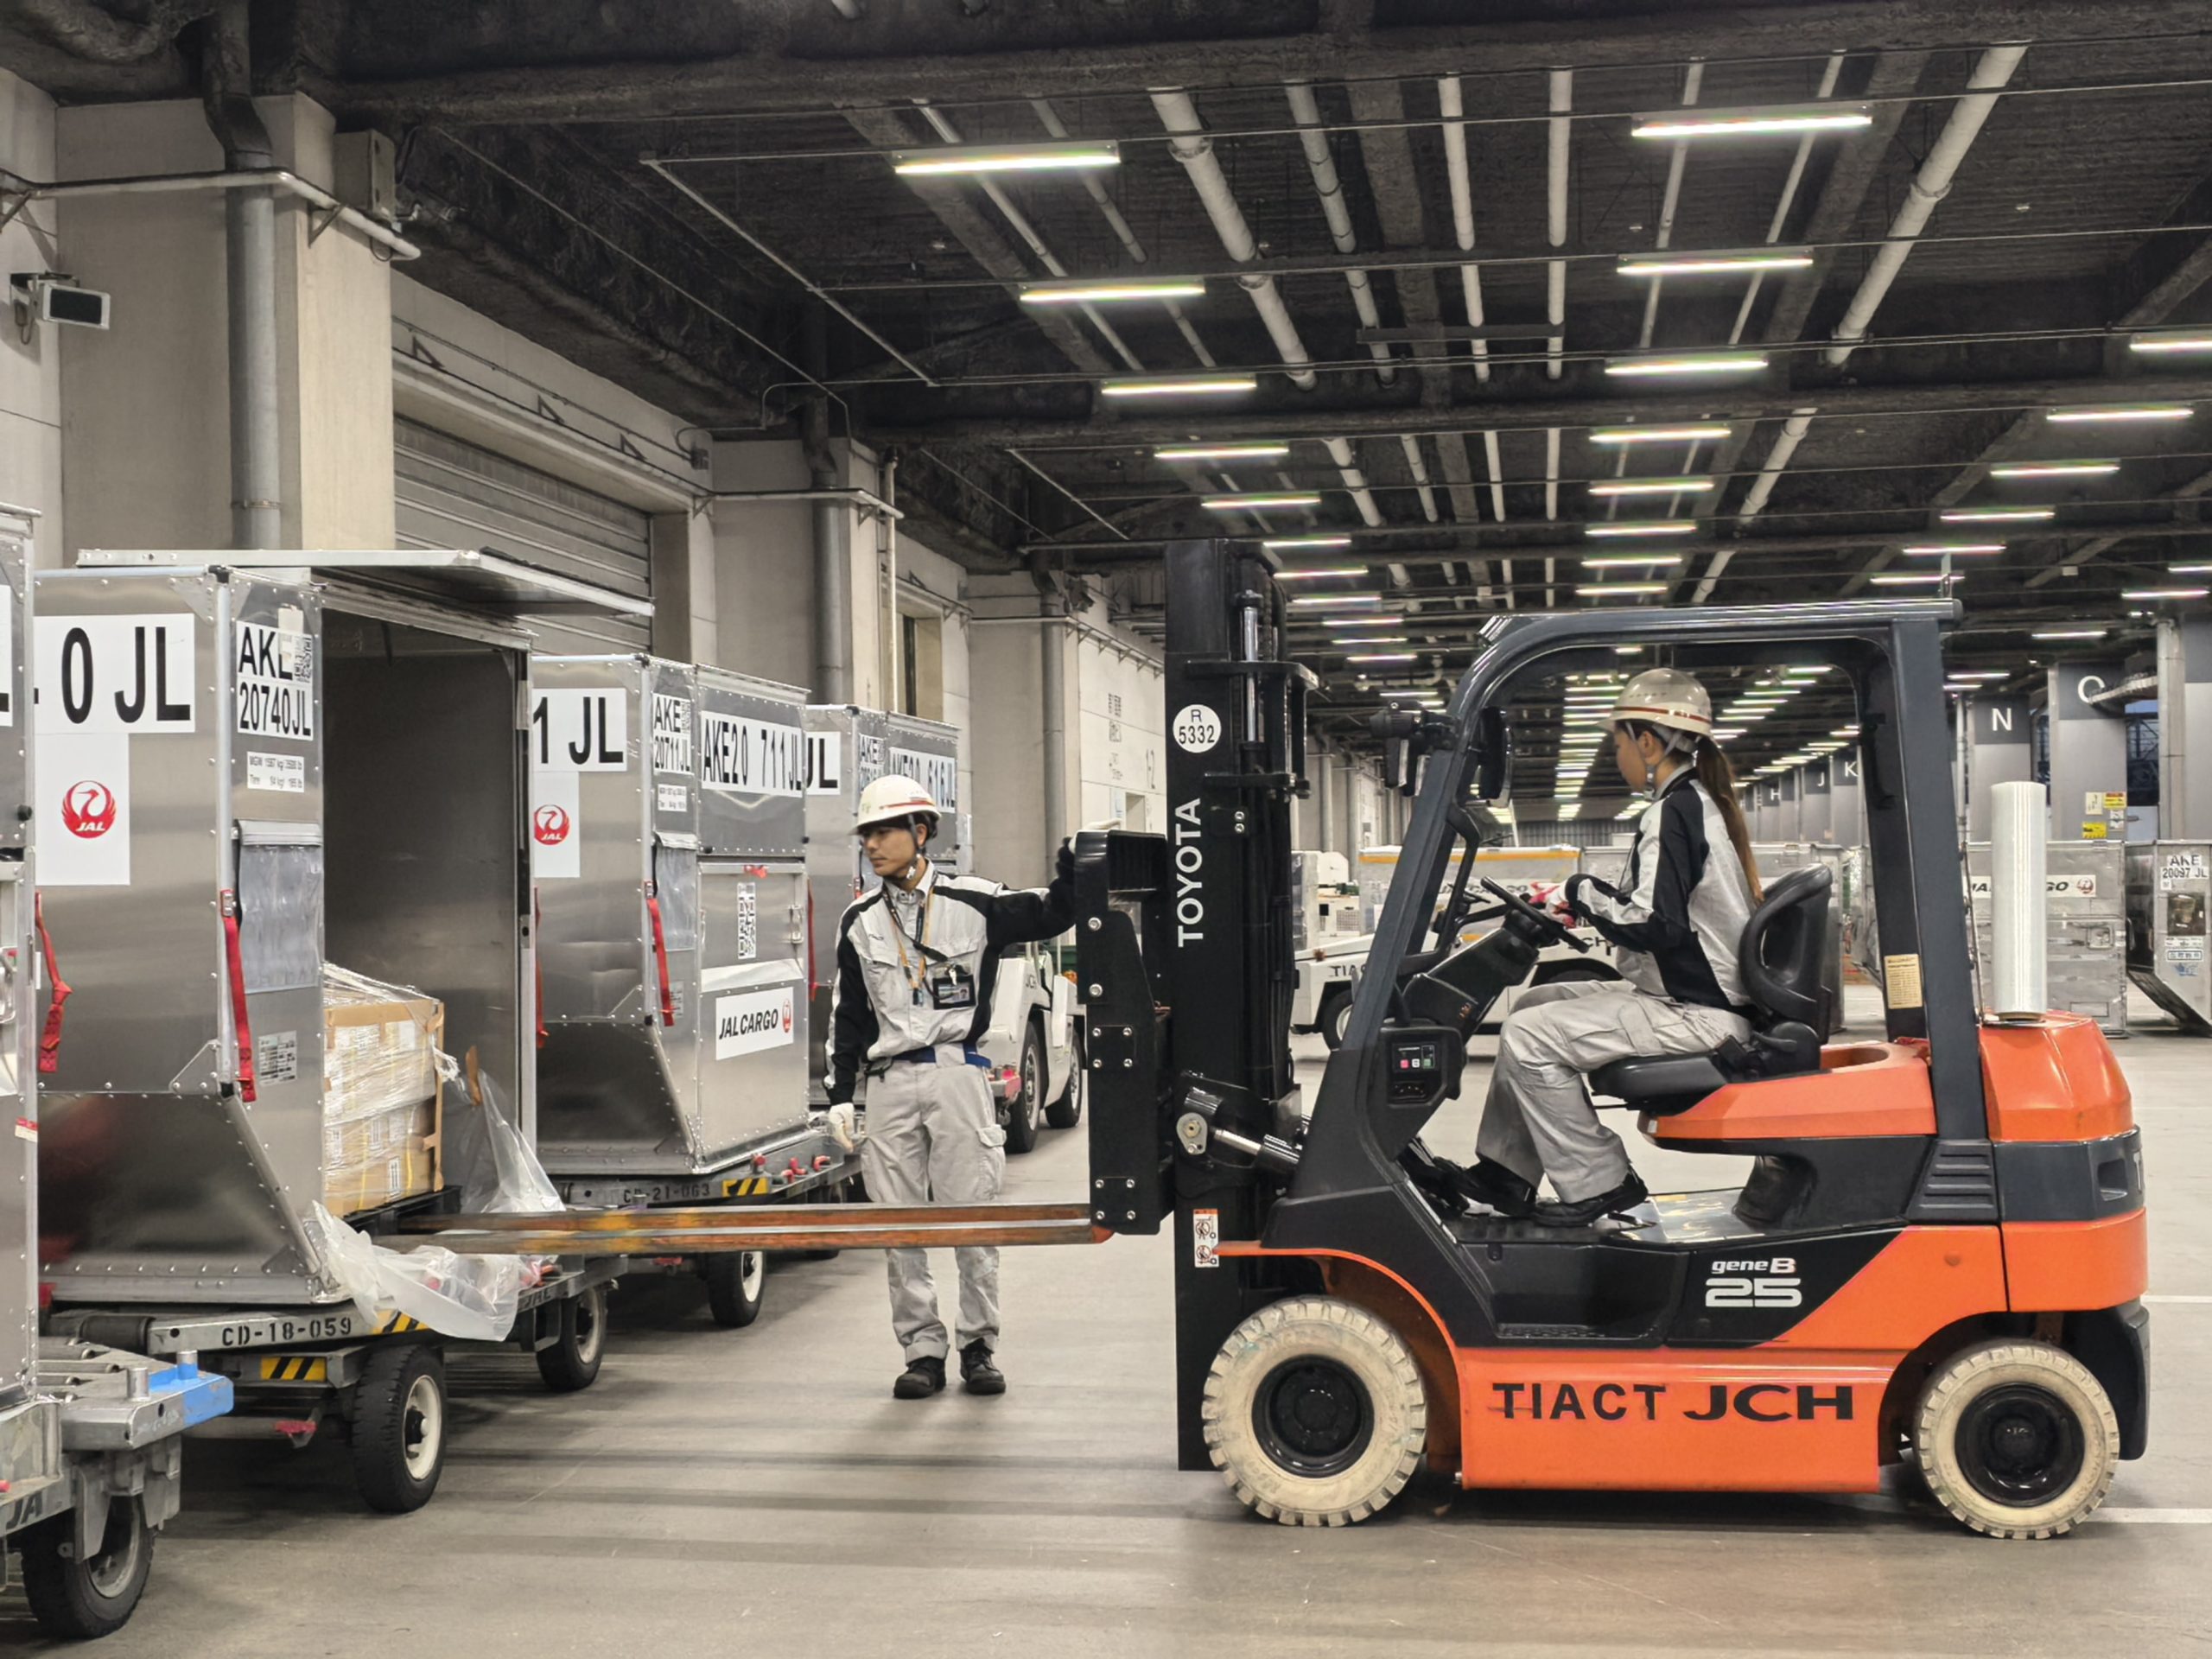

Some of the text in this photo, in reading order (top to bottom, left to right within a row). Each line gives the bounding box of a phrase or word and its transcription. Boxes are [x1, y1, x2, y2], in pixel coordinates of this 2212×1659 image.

[114, 626, 192, 723] JL
[238, 681, 312, 737] 20740JL
[654, 696, 681, 734] AKE
[1191, 709, 1202, 723] R
[1993, 708, 2012, 731] N
[568, 696, 625, 766] JL
[1179, 724, 1215, 745] 5332
[654, 734, 690, 772] 20711JL
[702, 717, 803, 791] AKE20 711JL
[806, 737, 838, 790] JL
[1845, 761, 1858, 777] K
[1770, 788, 1780, 800] H
[1817, 772, 1825, 787] J
[75, 821, 106, 832] JAL
[1174, 798, 1205, 948] TOYOTA
[719, 1008, 779, 1040] JAL CARGO
[1705, 1278, 1802, 1308] 25
[222, 1317, 353, 1347] CD-18-059
[1492, 1382, 1853, 1422] TIACT JCH
